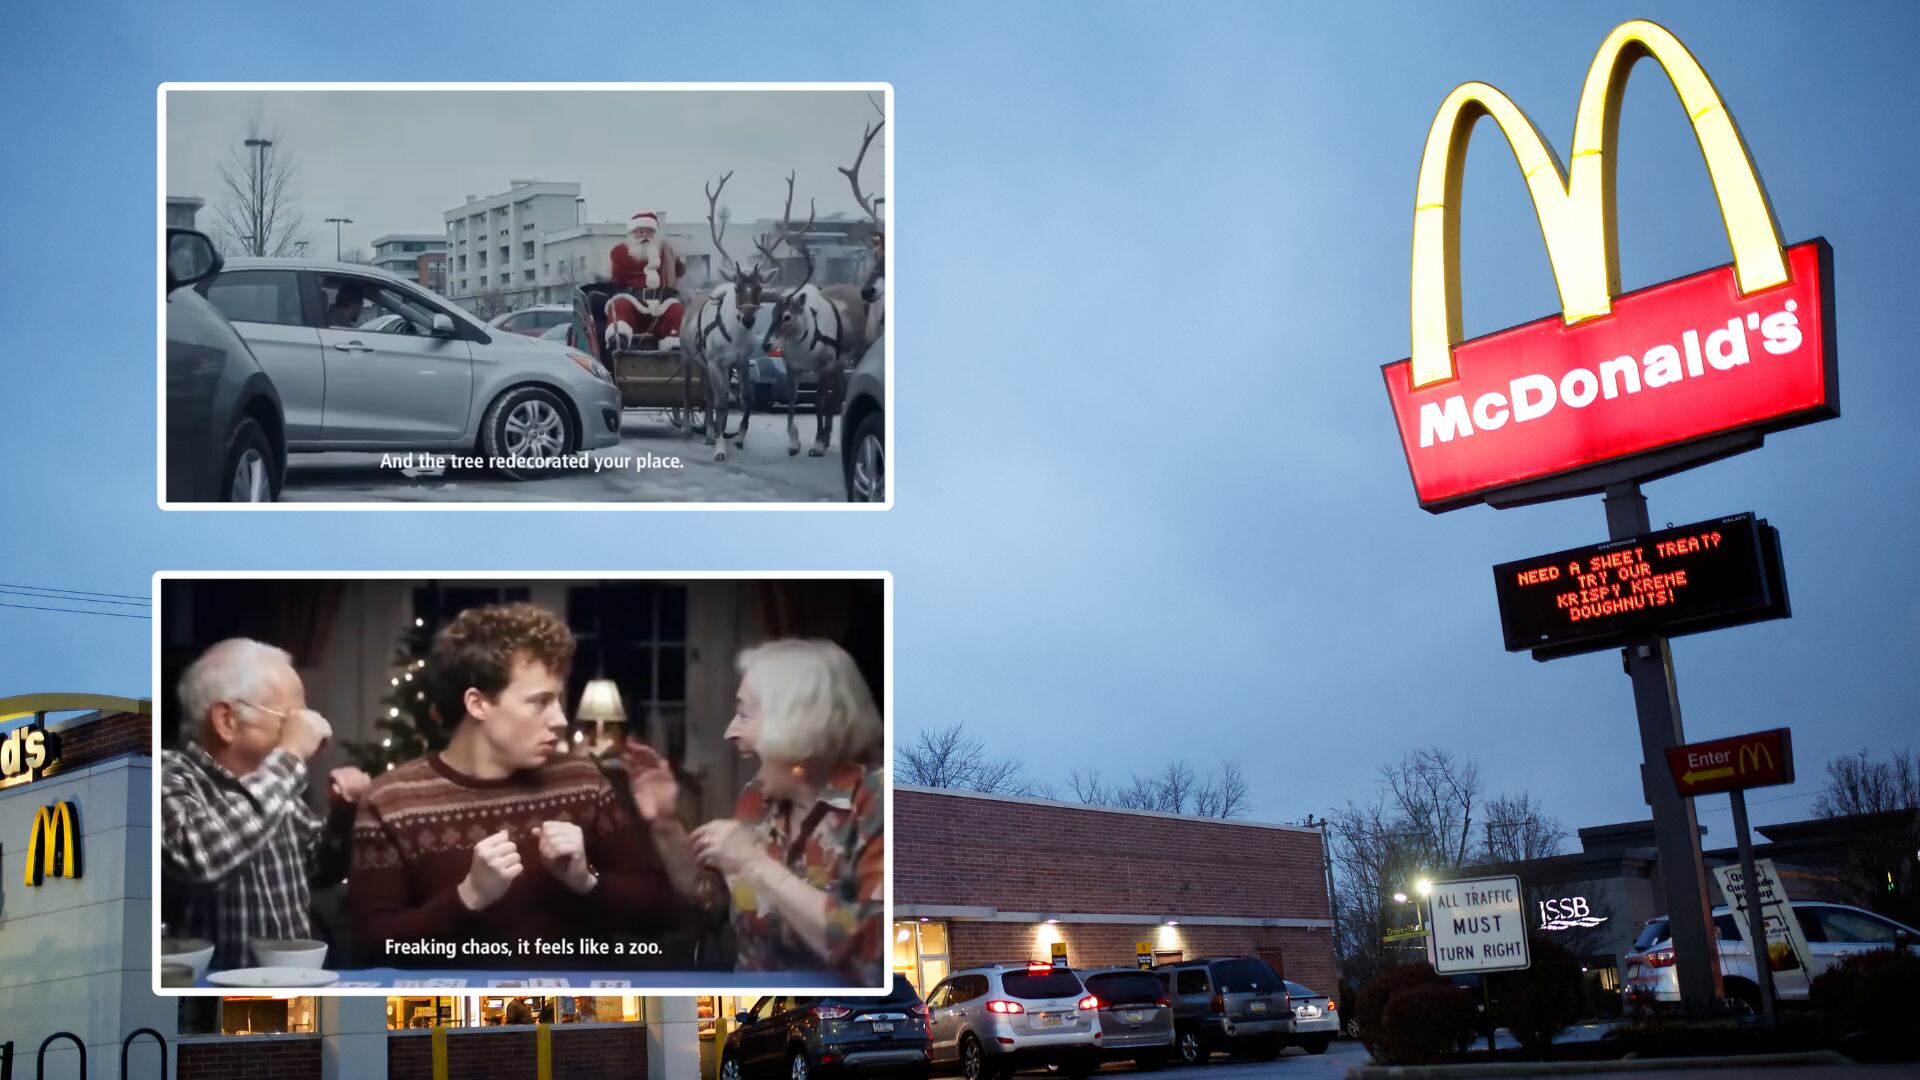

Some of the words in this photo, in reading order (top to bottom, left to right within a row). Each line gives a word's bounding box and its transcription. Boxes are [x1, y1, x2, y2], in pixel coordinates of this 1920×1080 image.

[1419, 310, 1803, 448] McDonald's
[1517, 567, 1560, 587] NEED
[1569, 561, 1581, 577] A
[1590, 547, 1644, 572] SWEET
[1656, 531, 1722, 557] TREAT?
[1578, 571, 1609, 589] TRY
[1618, 562, 1651, 581] OUR
[1556, 582, 1621, 609] KRISPY
[1631, 570, 1688, 594] KREME
[1569, 588, 1675, 622] DOUGHNUTS!
[1687, 750, 1731, 769] Enter
[1438, 894, 1459, 909] ALL
[1465, 889, 1513, 907] TRAFFIC
[1453, 915, 1503, 936] MUST
[1439, 944, 1475, 962] TURN
[1483, 941, 1522, 959] RIGHT
